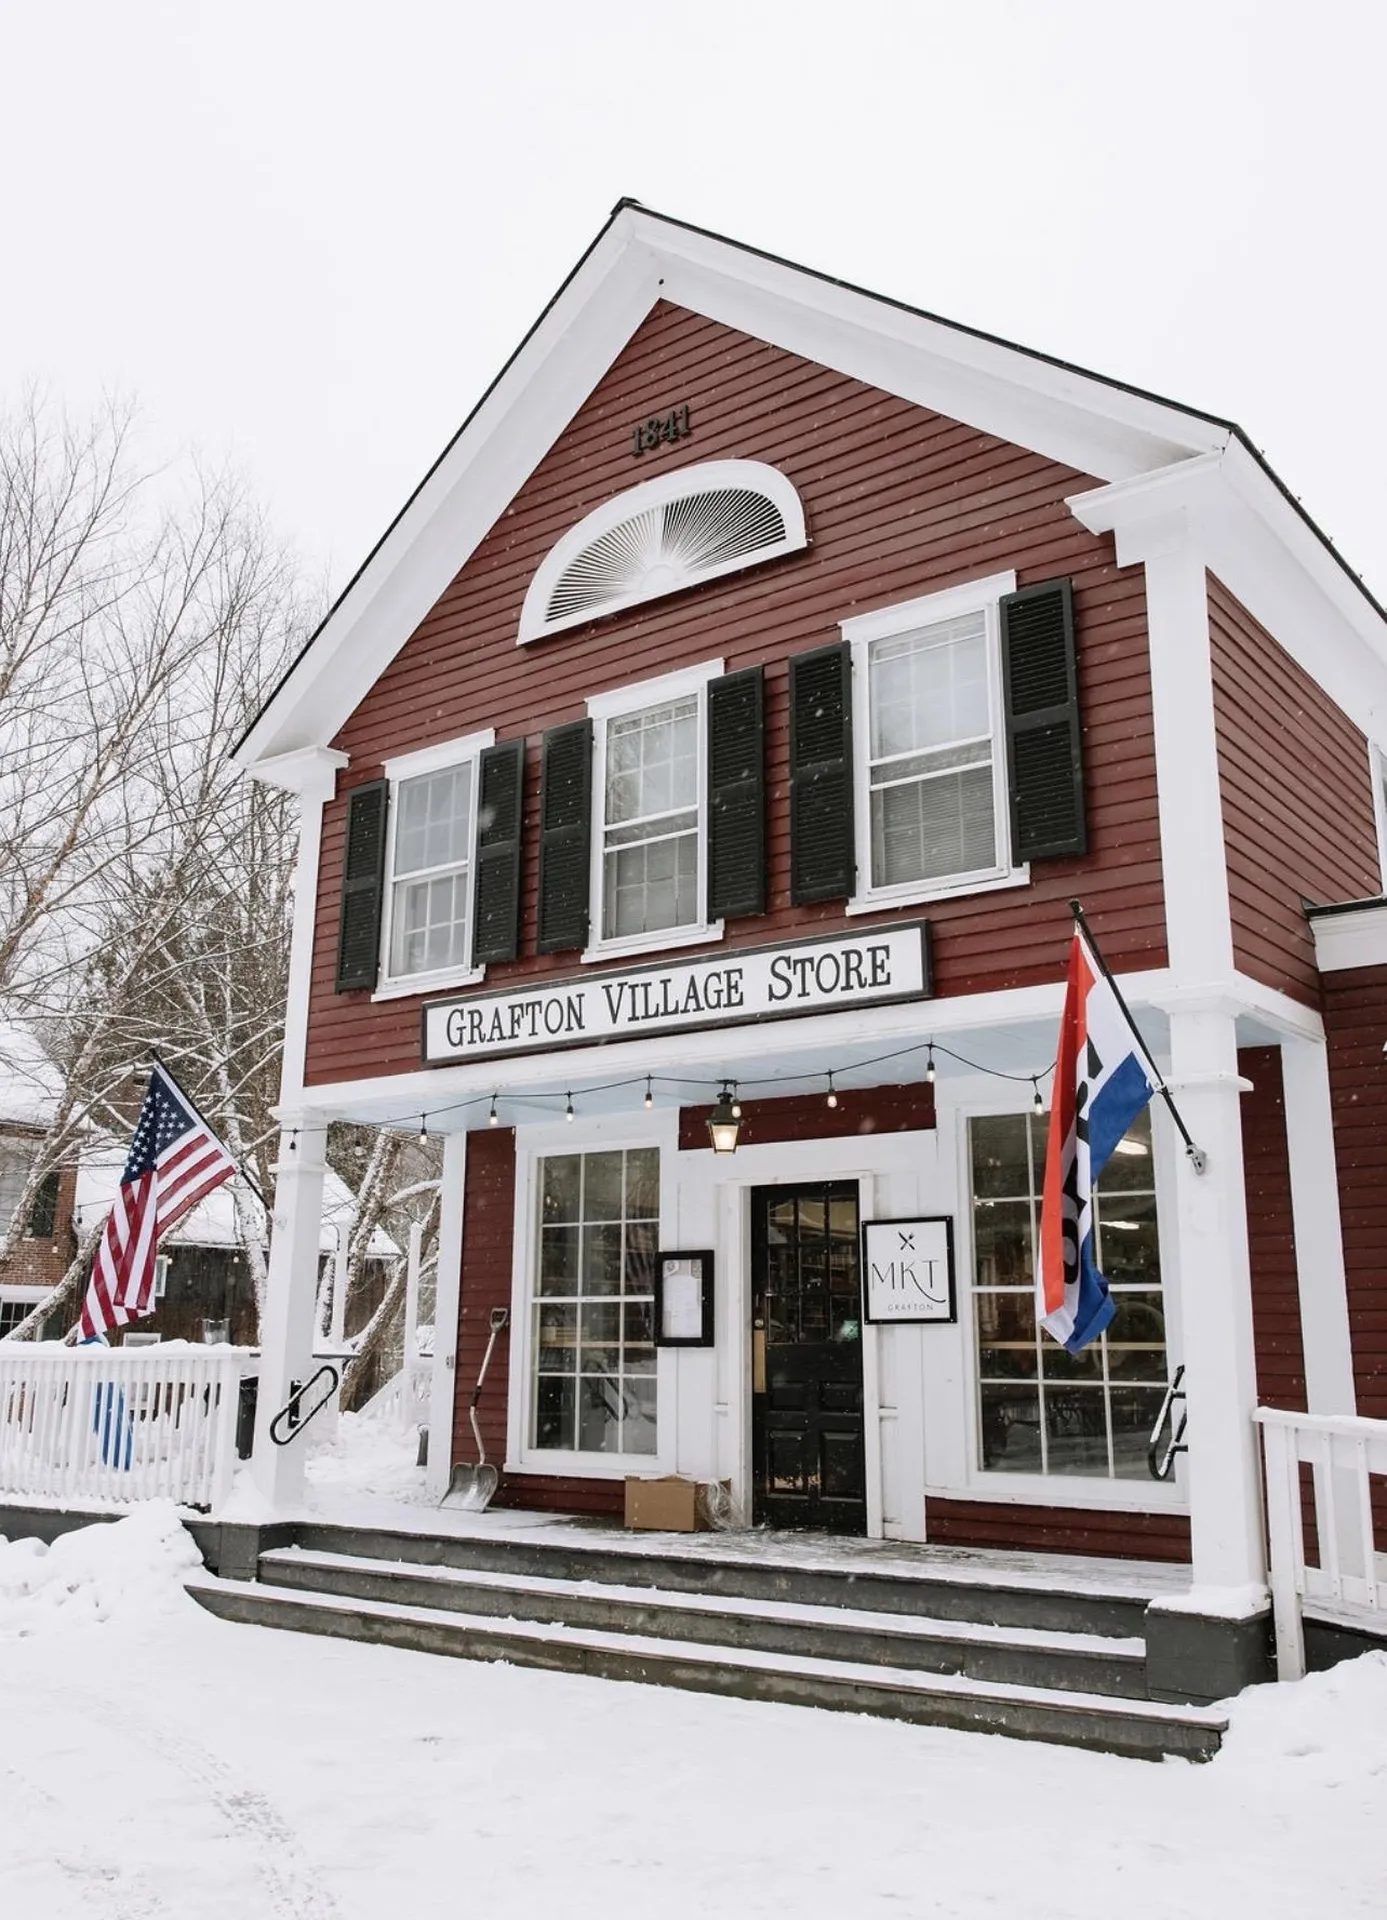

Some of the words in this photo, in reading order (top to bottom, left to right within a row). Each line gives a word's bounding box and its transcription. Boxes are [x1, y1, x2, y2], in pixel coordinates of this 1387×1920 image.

[632, 404, 692, 457] 1841
[446, 993, 586, 1047] GRAFTON
[602, 968, 744, 1025] VILLAGE
[768, 944, 892, 1002] STORE
[871, 1260, 946, 1303] MKT
[887, 1303, 934, 1312] GRAFTON
